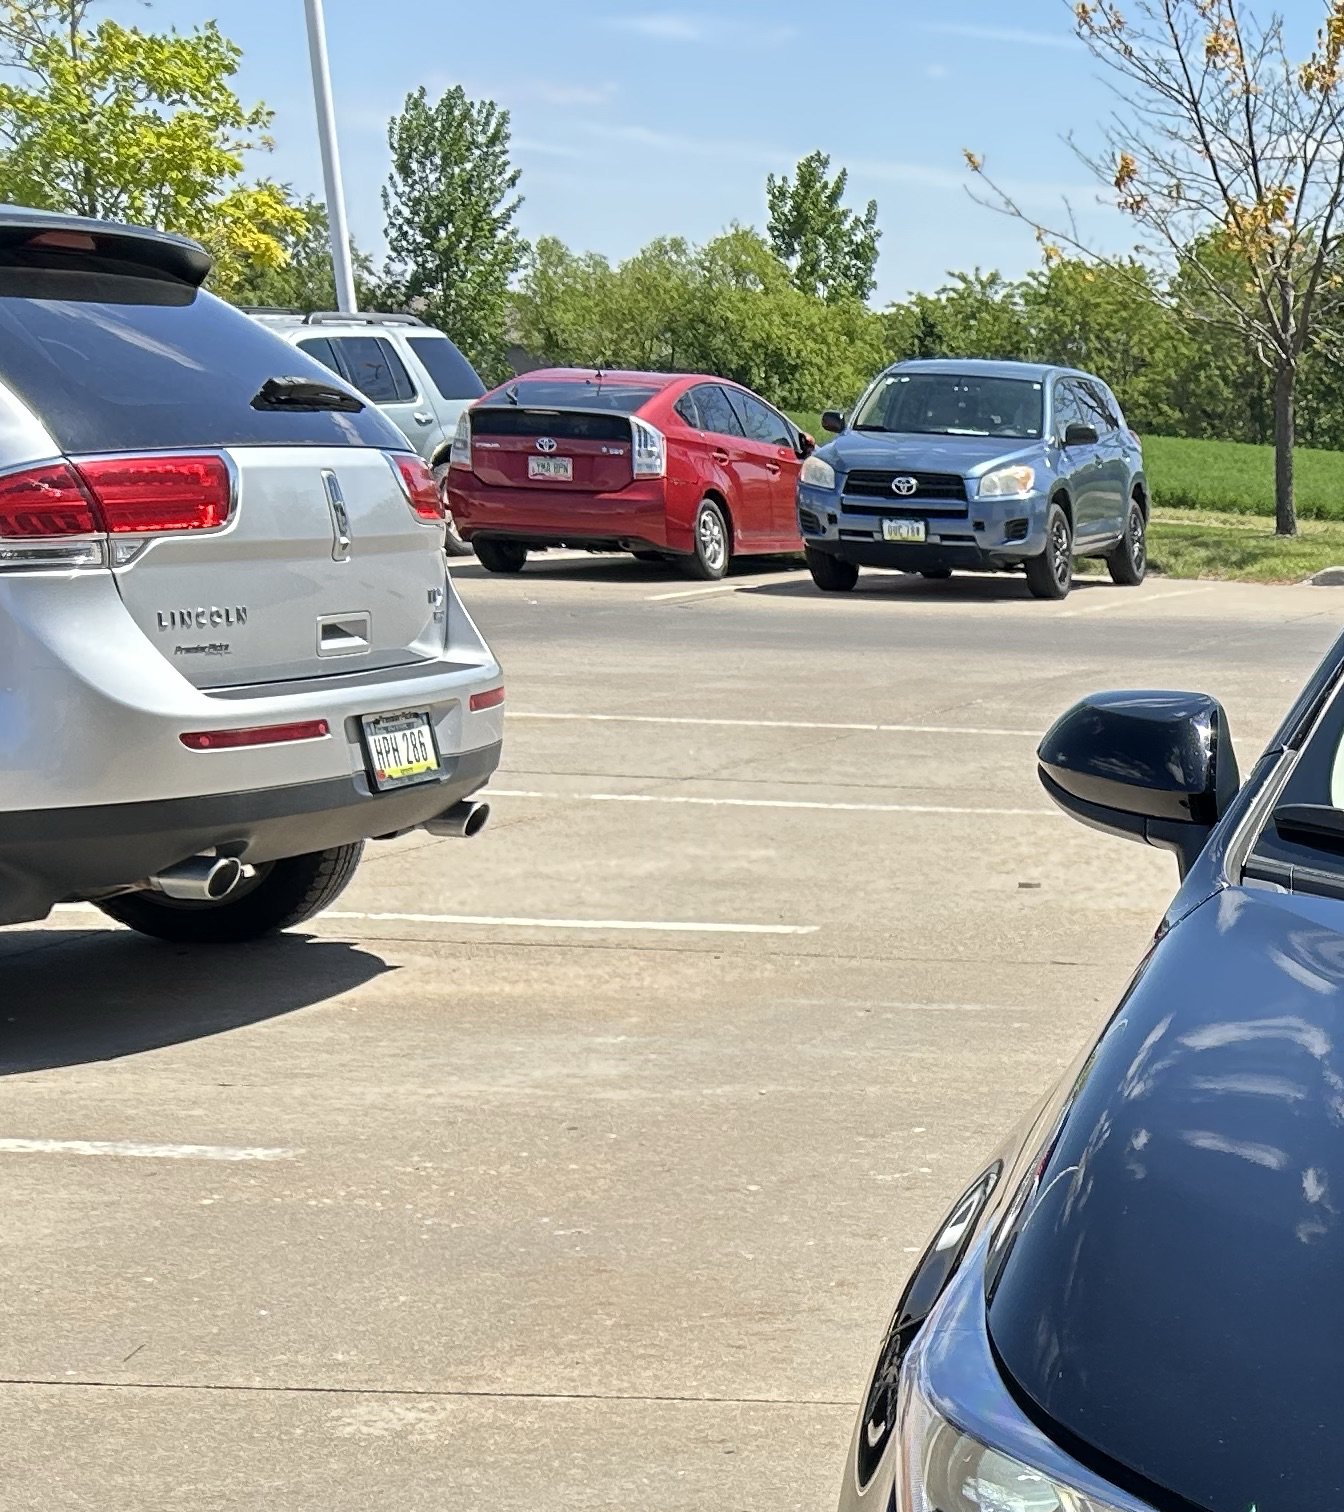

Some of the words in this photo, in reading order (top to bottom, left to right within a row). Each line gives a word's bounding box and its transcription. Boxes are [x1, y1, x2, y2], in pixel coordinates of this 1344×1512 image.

[157, 605, 248, 627] LINCOLN
[374, 734, 402, 770] HPH
[402, 729, 428, 765] 286
